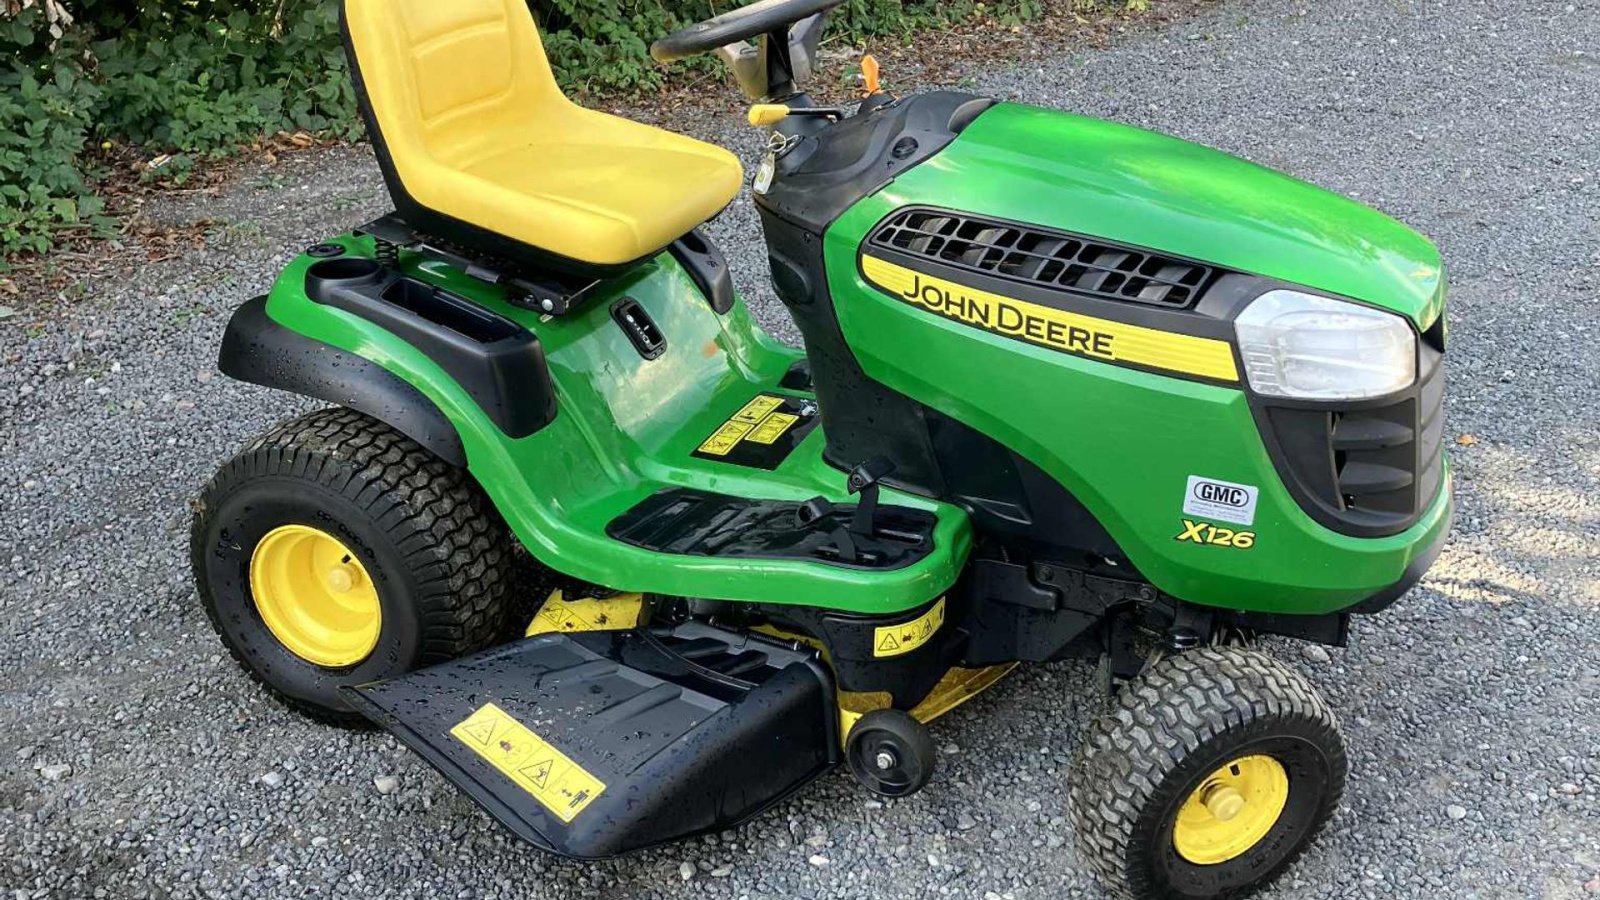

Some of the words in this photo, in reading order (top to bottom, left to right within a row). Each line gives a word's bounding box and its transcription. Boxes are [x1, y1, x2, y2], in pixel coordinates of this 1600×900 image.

[904, 275, 990, 324] JOHN
[998, 304, 1114, 356] DEERE
[1201, 484, 1242, 505] GMC
[1176, 519, 1256, 549] X126
